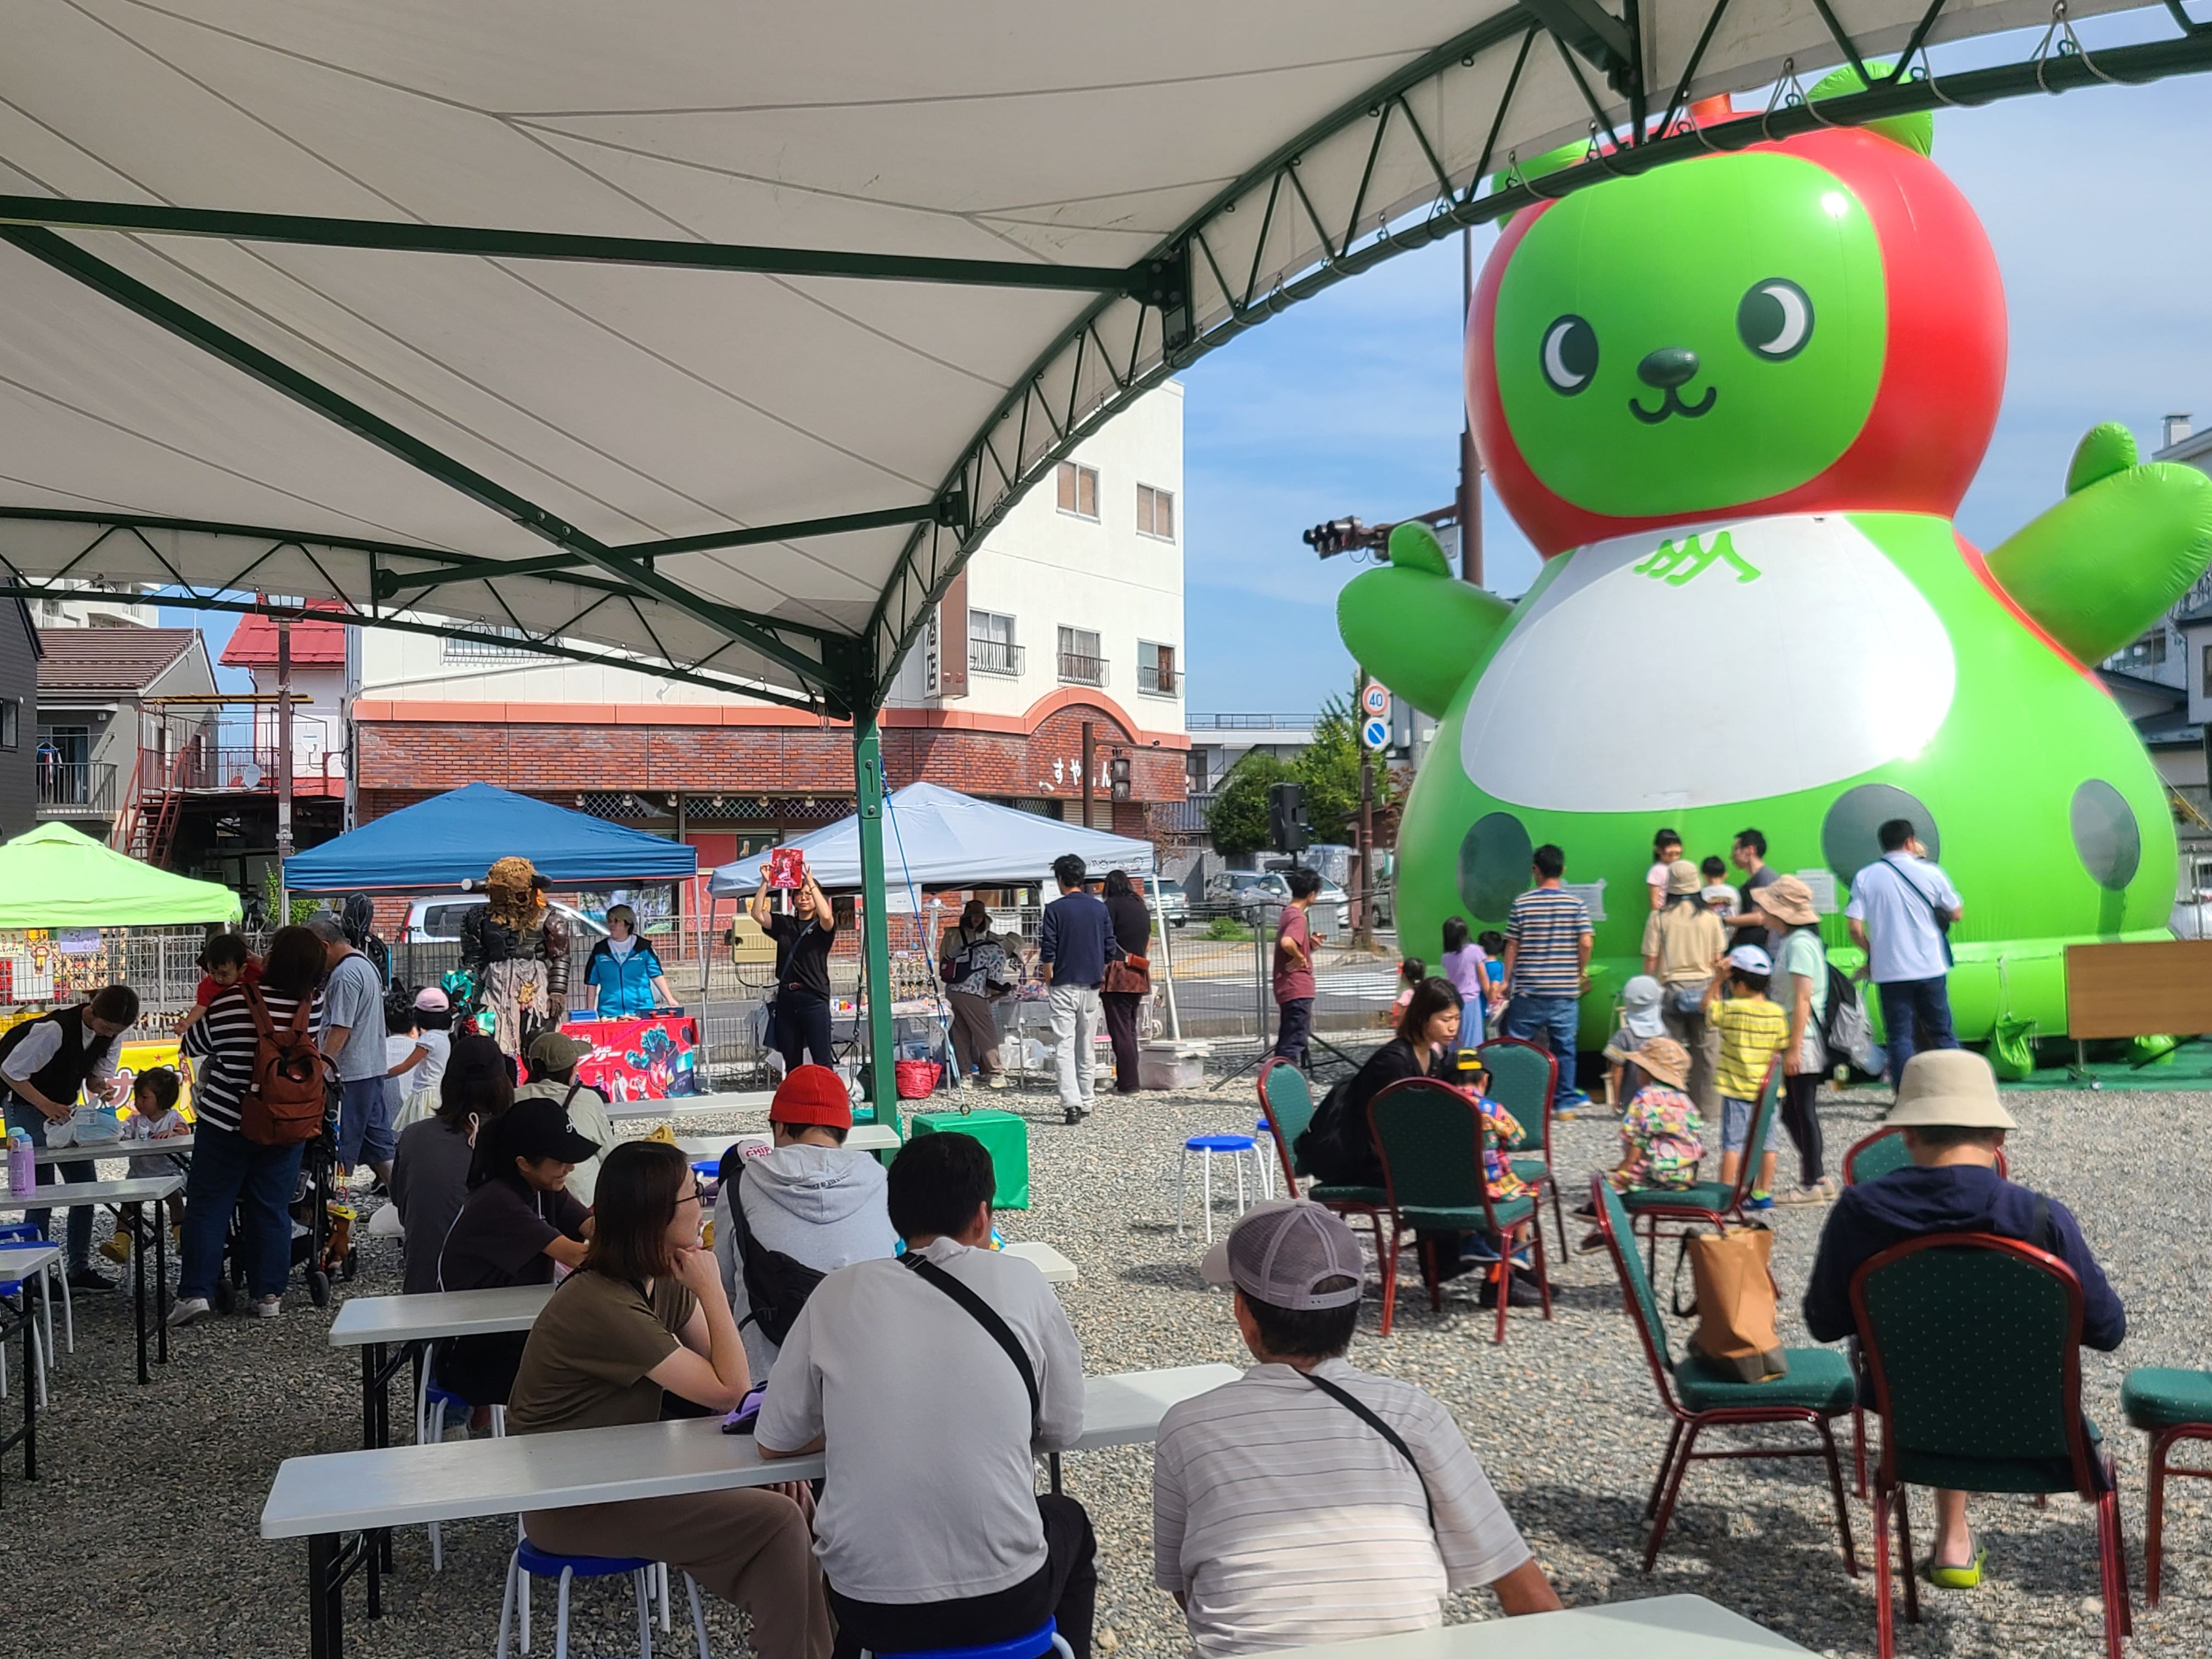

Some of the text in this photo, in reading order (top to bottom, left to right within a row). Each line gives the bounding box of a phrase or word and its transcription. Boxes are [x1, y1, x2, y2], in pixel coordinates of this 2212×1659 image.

[1369, 693, 1383, 707] 40
[1053, 758, 1111, 788] すやん
